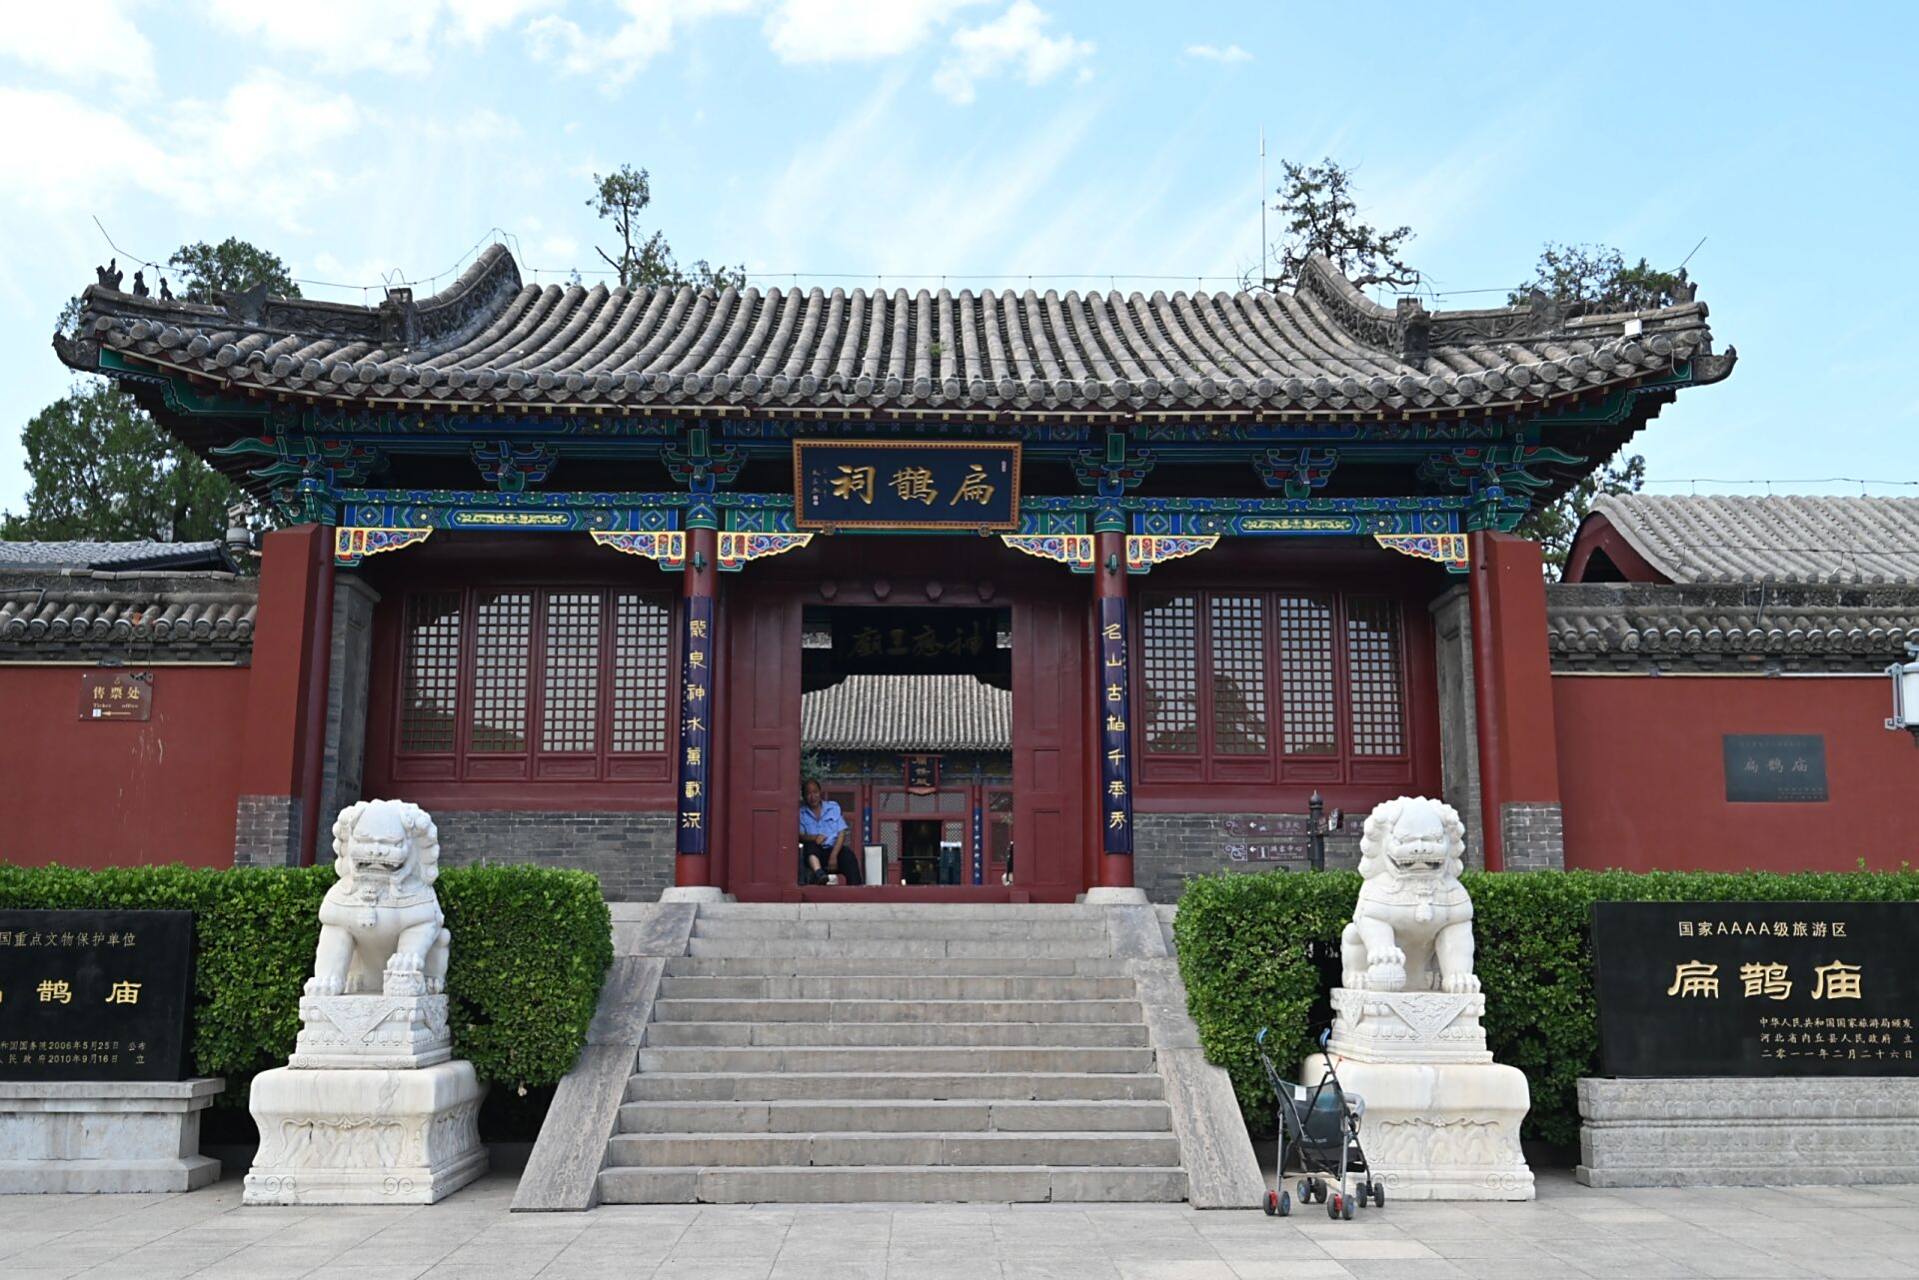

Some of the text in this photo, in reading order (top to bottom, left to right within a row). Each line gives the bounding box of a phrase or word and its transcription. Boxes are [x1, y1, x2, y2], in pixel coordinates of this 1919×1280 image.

[1679, 921, 1847, 937] 国家AAAA级旅游区
[0, 979, 142, 1004] 鹊庙
[1667, 960, 1862, 1000] 扁鹊庙
